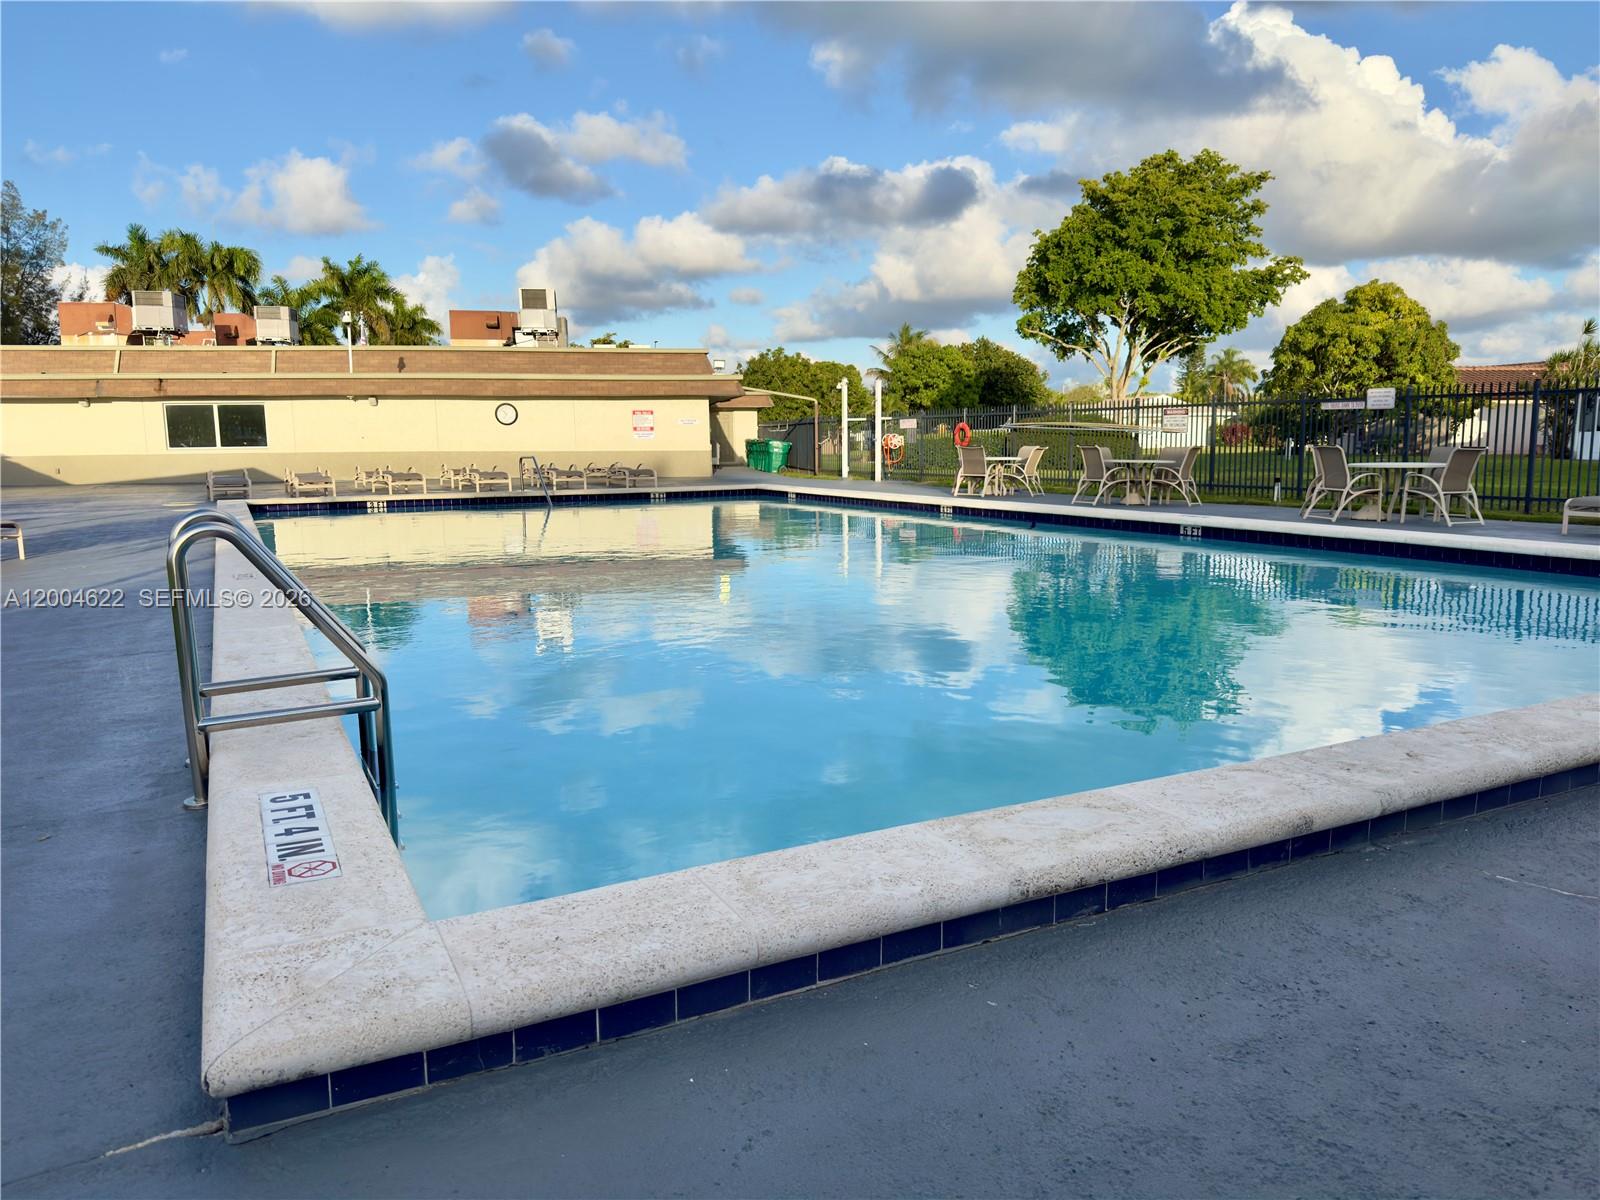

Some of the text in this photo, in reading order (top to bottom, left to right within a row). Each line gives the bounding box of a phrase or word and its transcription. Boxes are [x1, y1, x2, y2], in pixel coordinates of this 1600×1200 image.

[269, 792, 325, 861] 5 FT. 4 IN.
